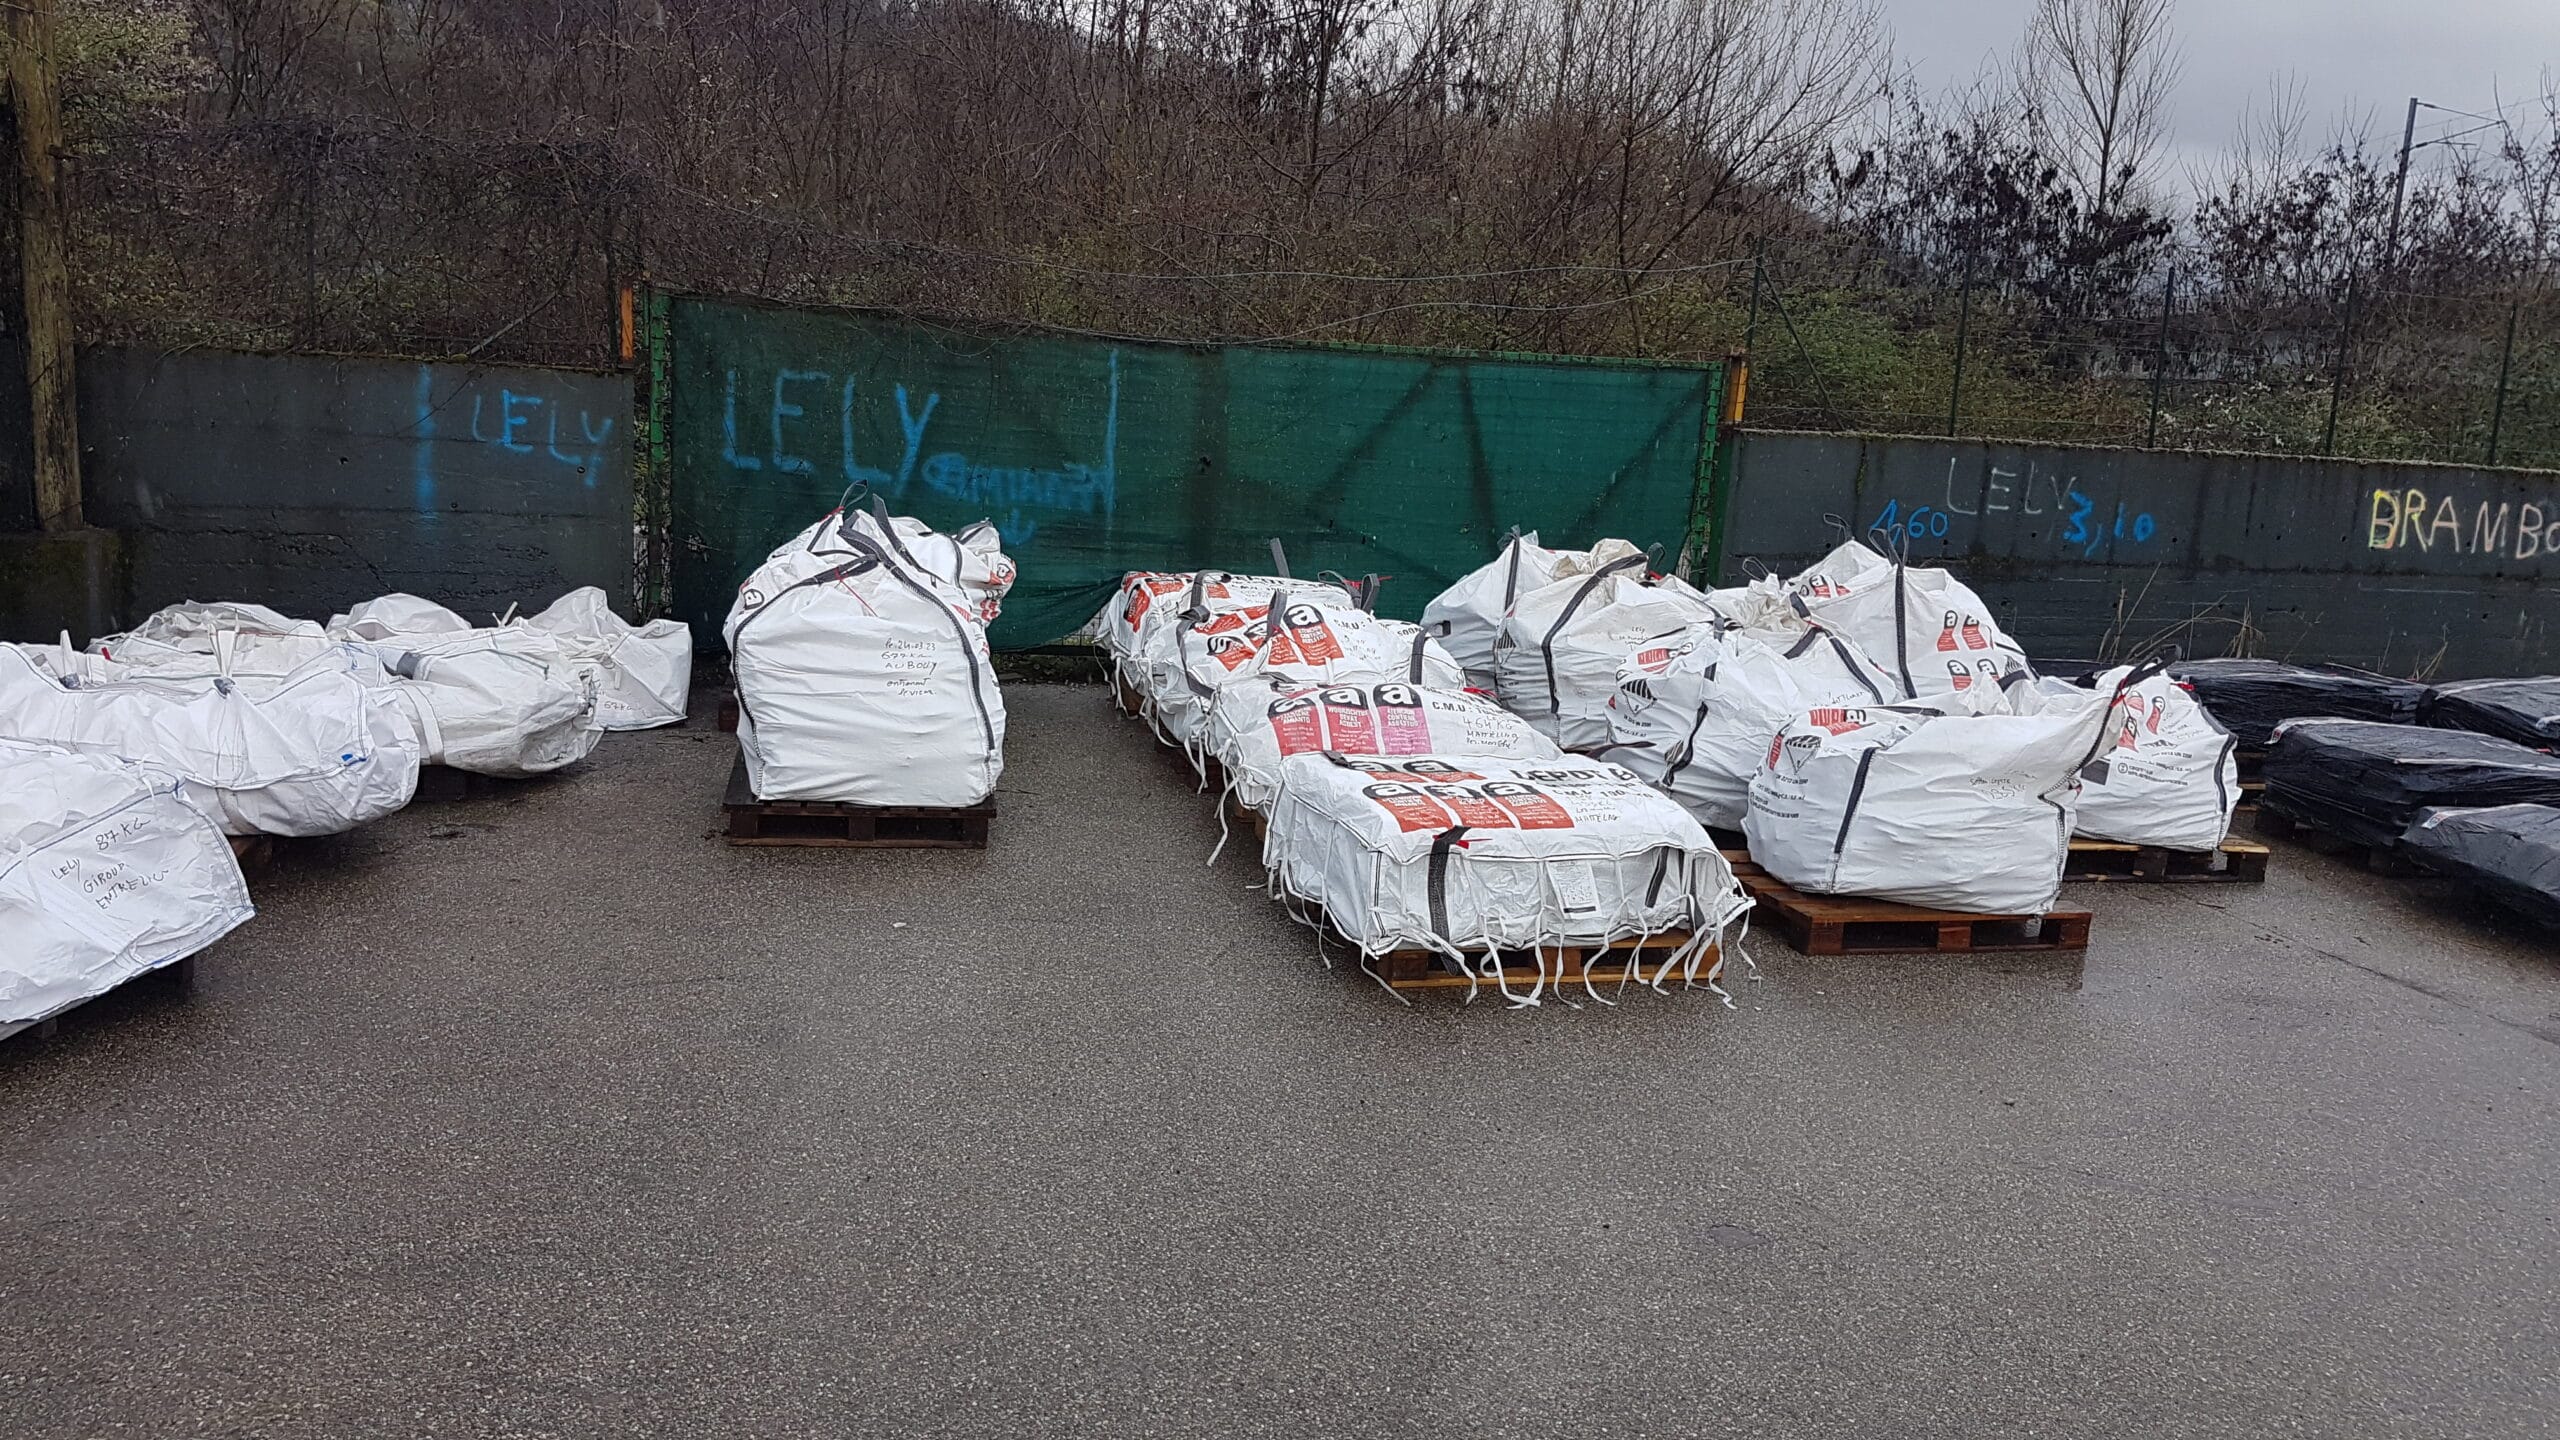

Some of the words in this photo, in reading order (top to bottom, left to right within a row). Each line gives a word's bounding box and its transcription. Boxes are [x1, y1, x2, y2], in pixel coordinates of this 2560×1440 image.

[471, 388, 613, 488] LELY
[722, 370, 939, 496] LELY
[1946, 457, 2077, 515] LELY
[51, 858, 80, 882] LELY
